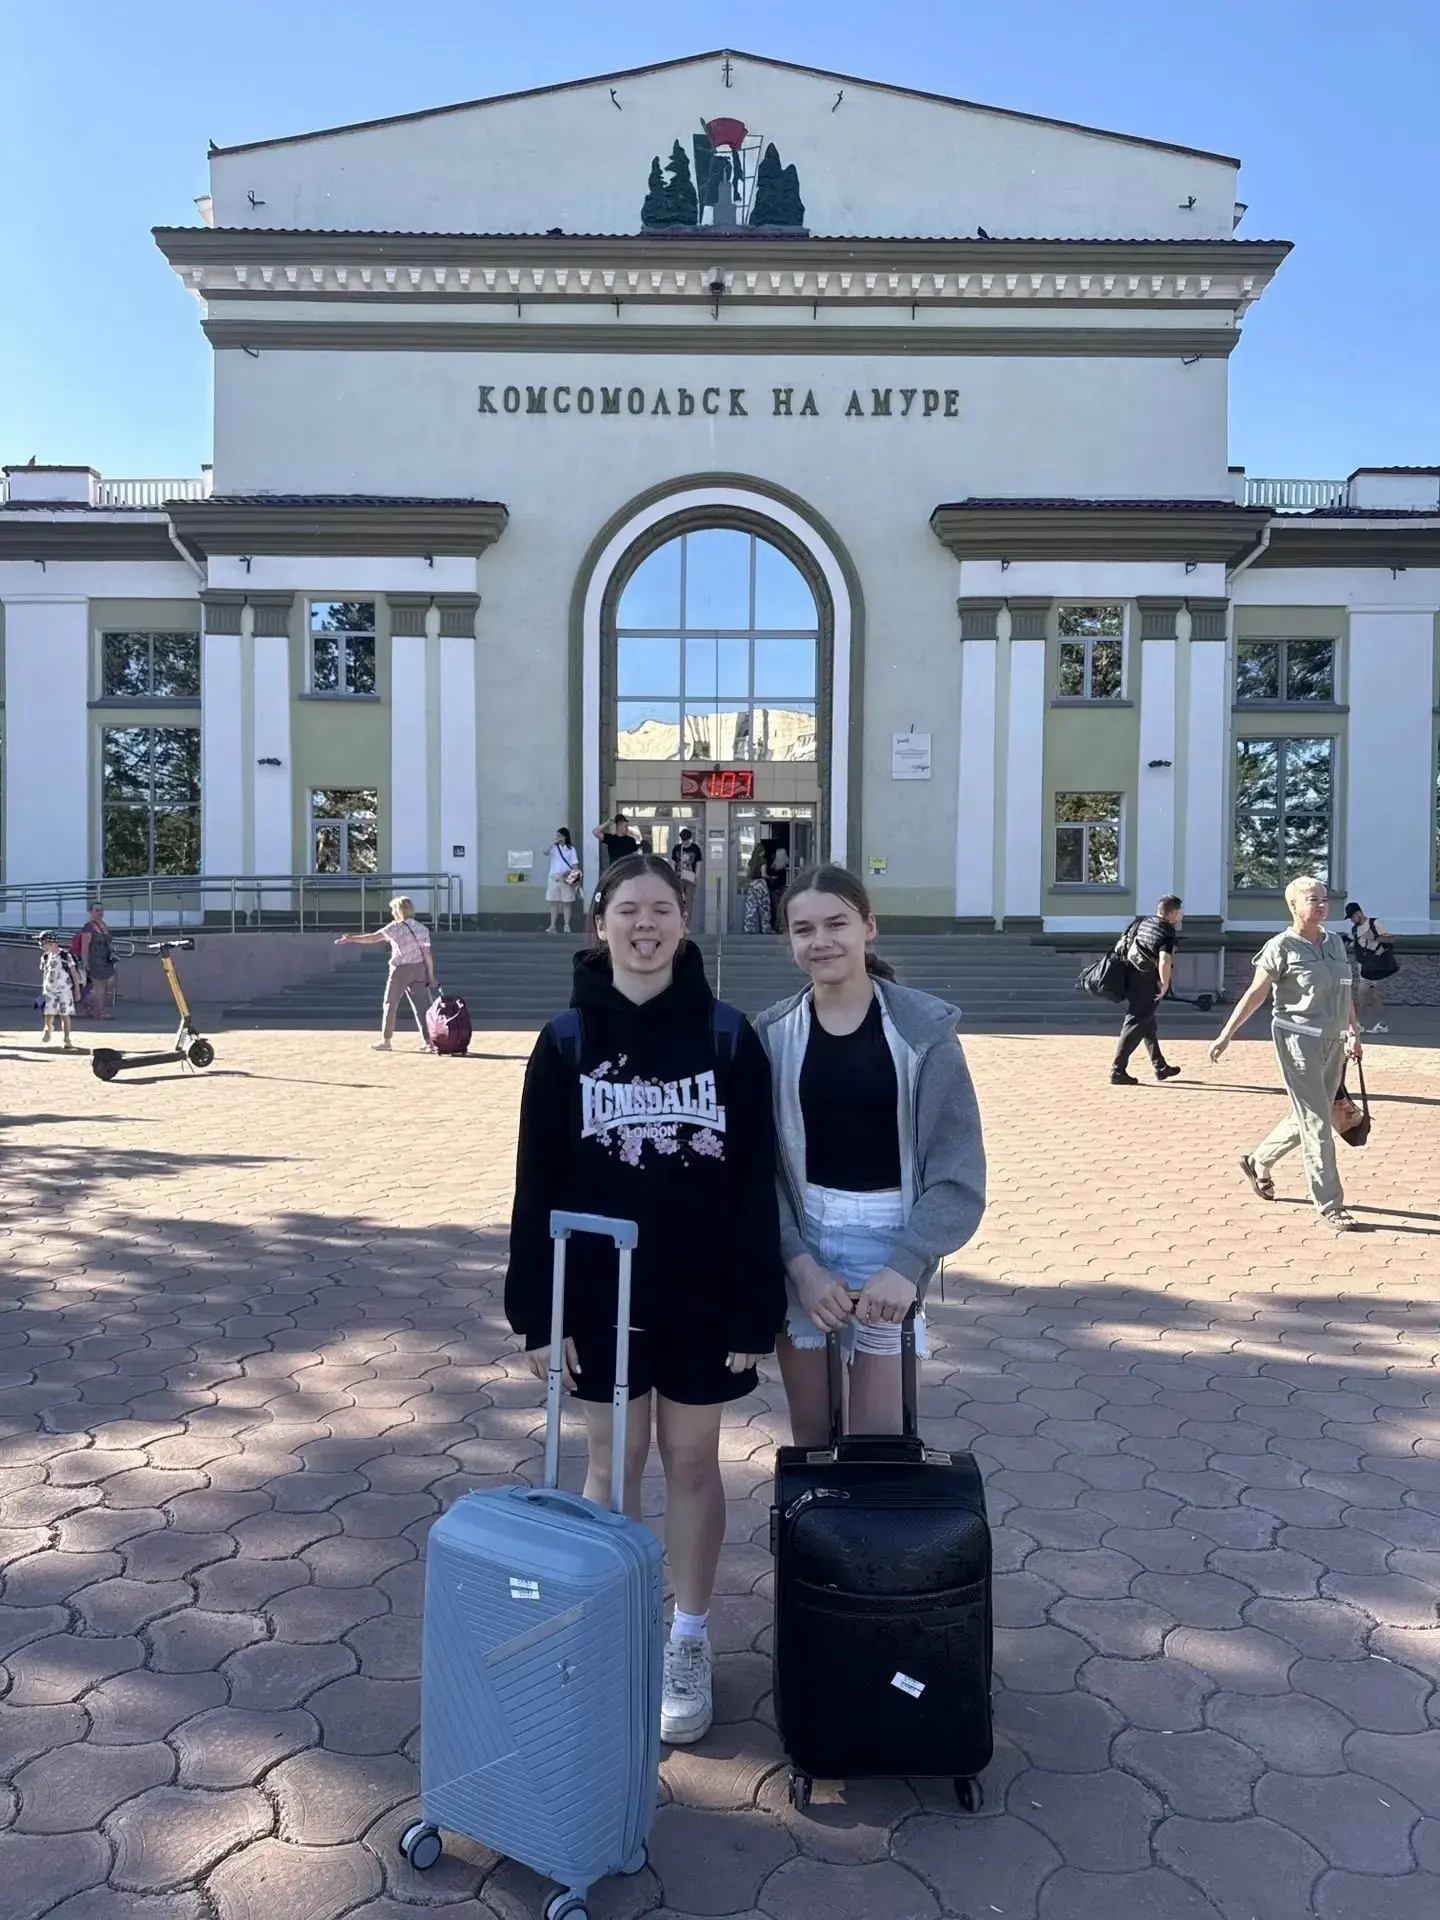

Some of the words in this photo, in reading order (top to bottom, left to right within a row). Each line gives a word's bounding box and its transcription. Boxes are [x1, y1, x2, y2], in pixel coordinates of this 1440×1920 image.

[478, 386, 748, 416] КОМСОМОЛЬСК
[772, 388, 820, 416] НА
[845, 388, 960, 417] АМУРЕ
[626, 1124, 678, 1139] LONDON
